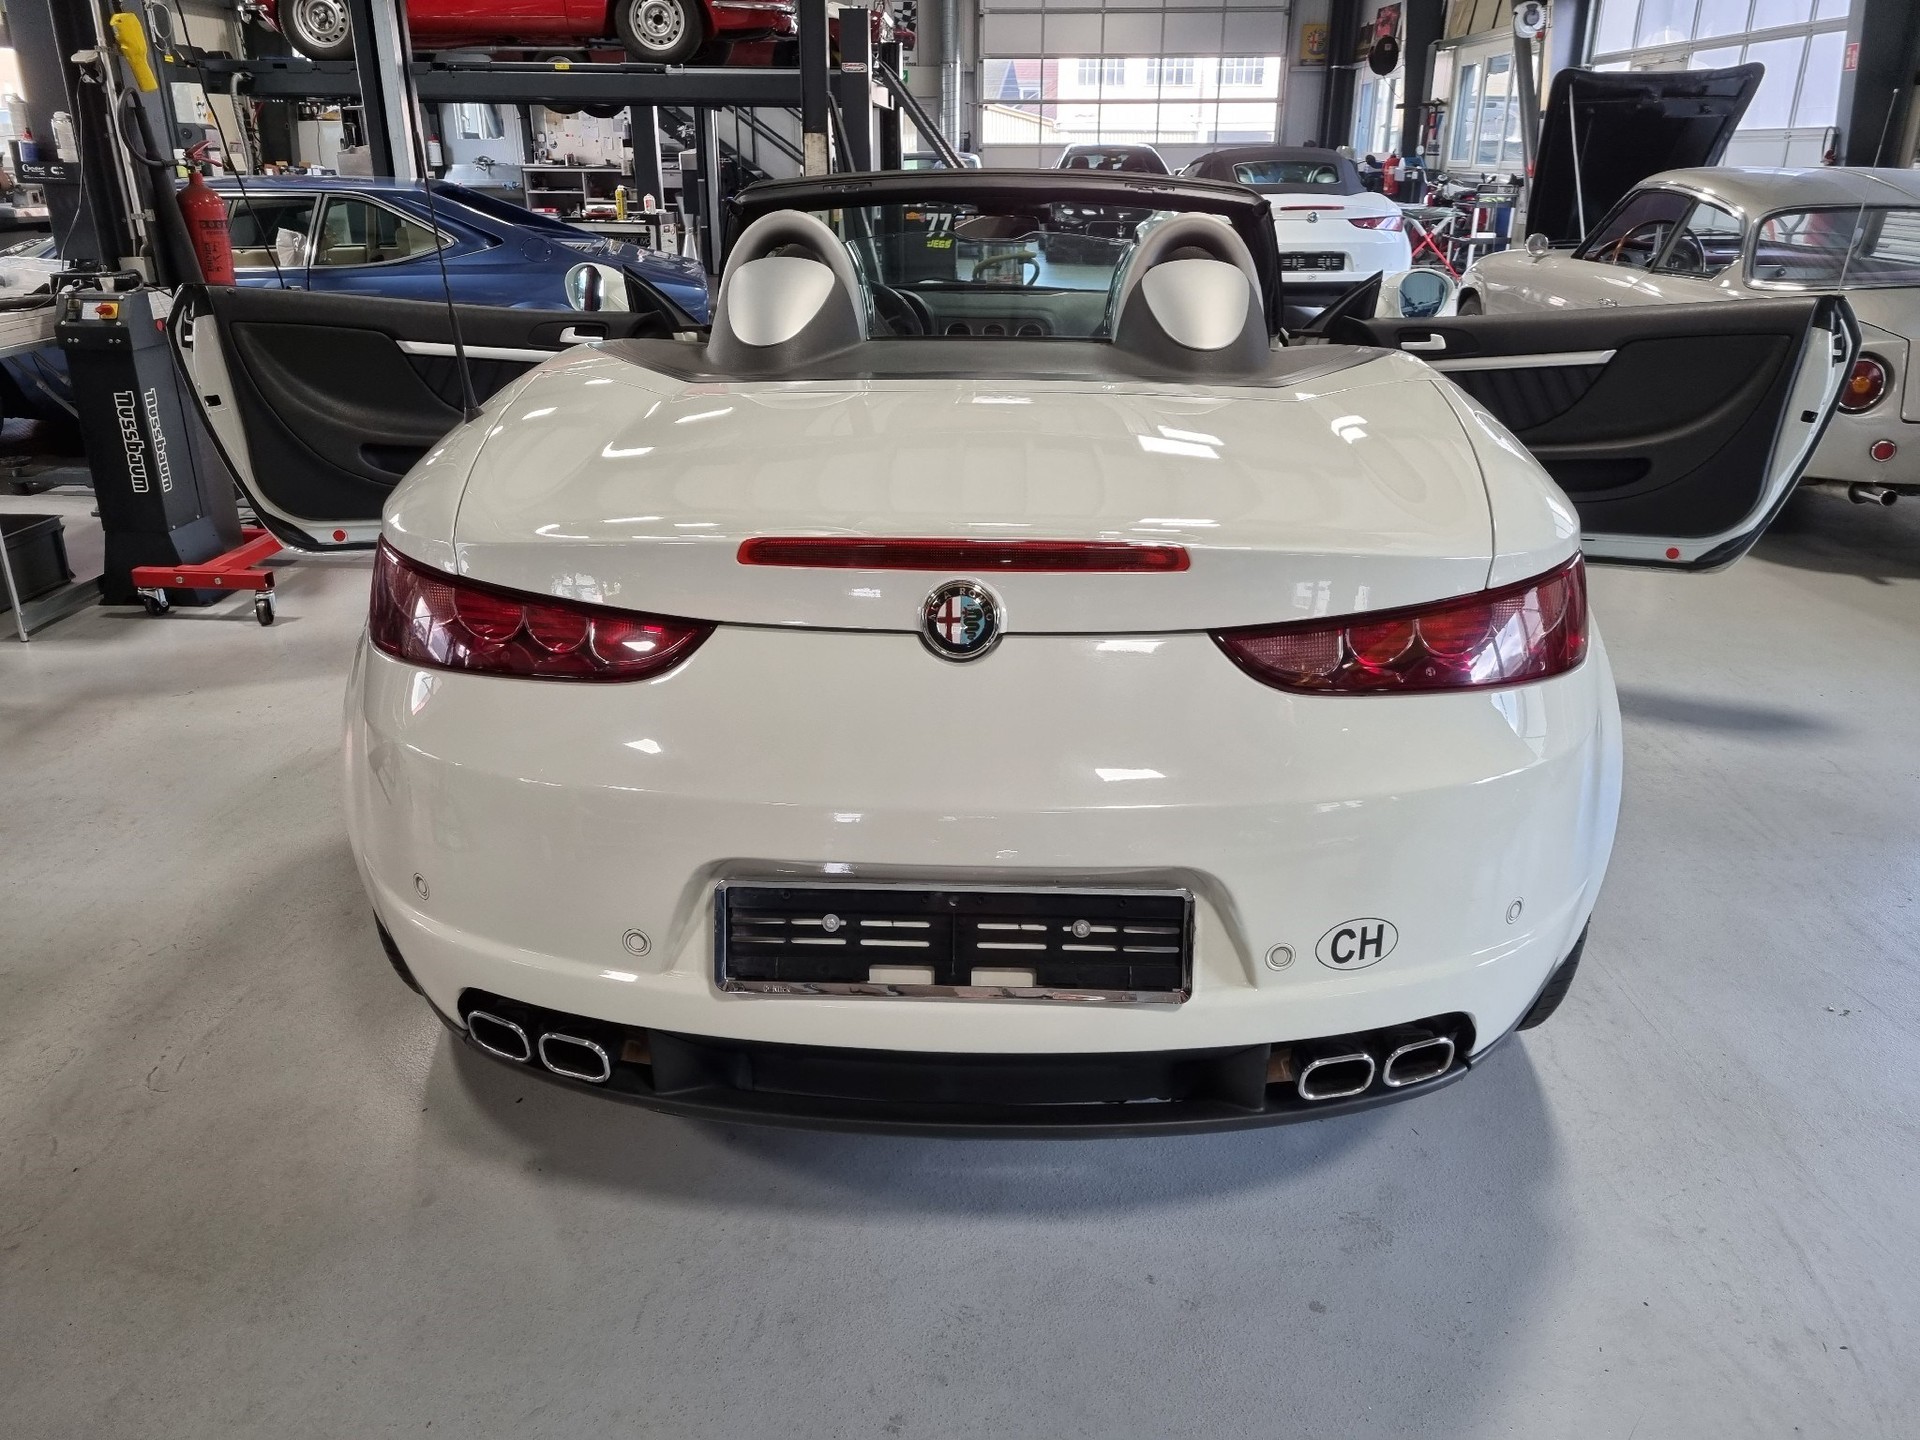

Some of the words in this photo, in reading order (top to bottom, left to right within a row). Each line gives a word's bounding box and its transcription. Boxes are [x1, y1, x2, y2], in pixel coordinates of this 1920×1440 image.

[926, 213, 952, 238] 77
[113, 390, 149, 492] nussbaum
[144, 388, 173, 492] nussbaum
[928, 591, 952, 622] ALFA
[959, 587, 993, 621] ROMEO
[1331, 924, 1384, 964] CH
